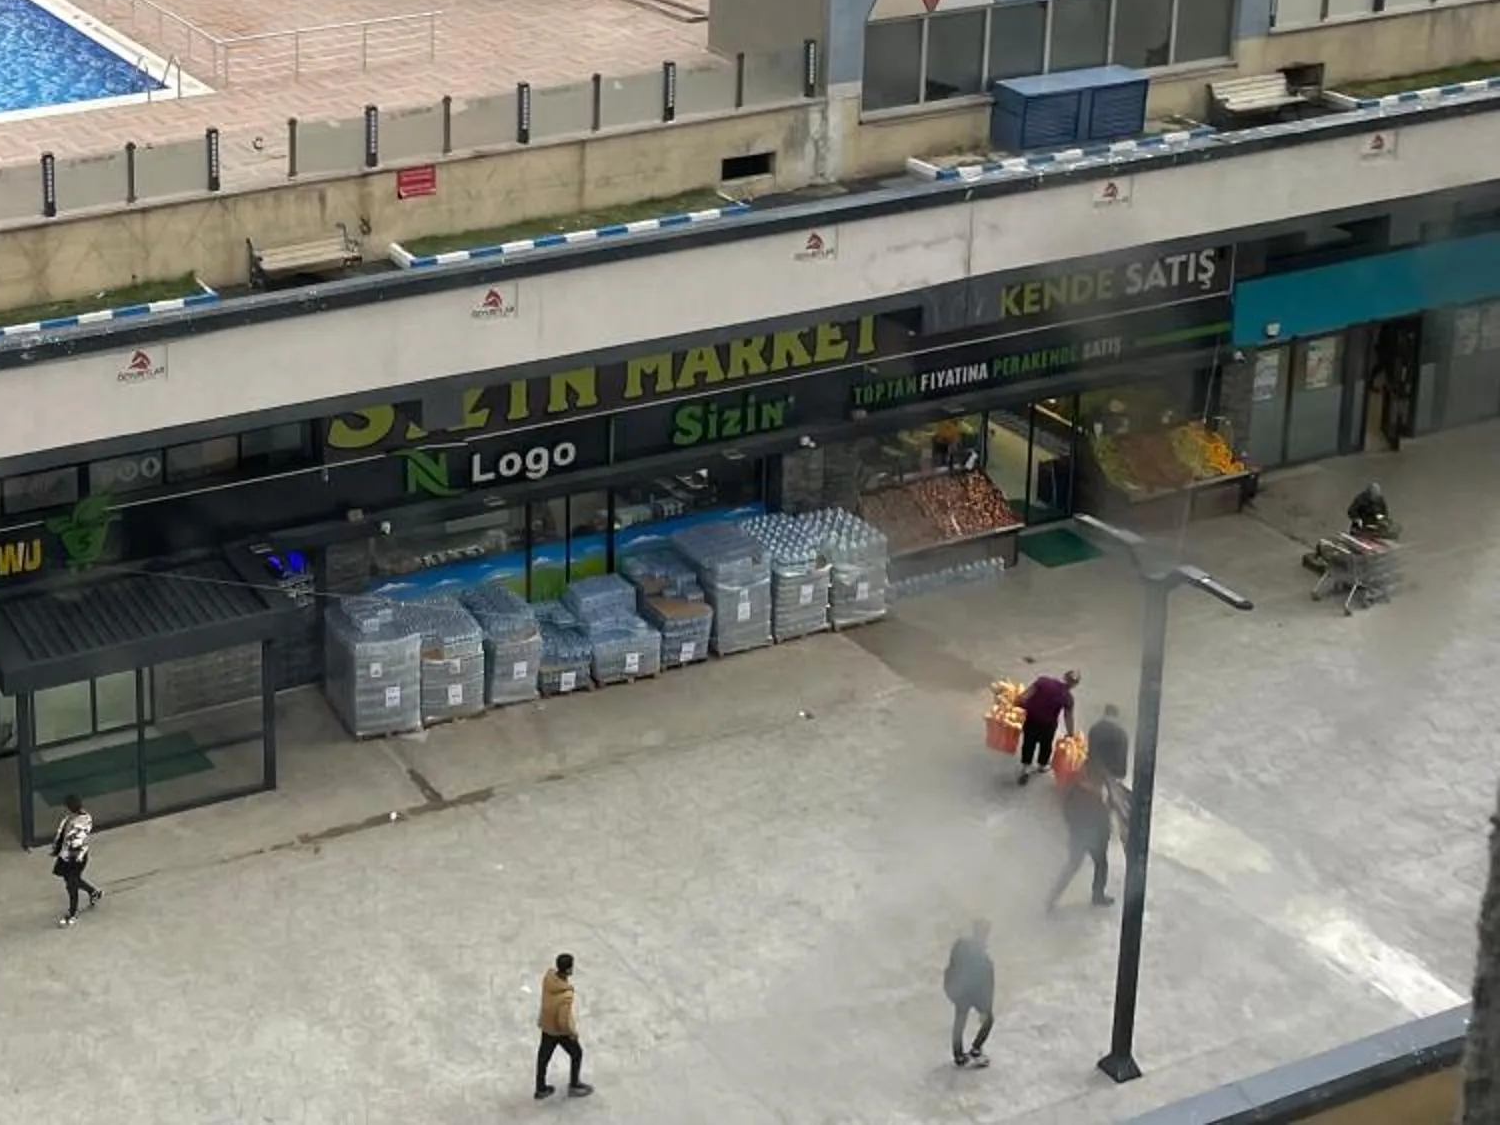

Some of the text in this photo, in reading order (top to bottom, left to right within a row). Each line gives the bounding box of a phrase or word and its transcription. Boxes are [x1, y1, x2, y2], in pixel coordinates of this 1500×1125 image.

[1000, 248, 1216, 318] KENDE SATIŞ
[854, 376, 918, 405] TOPTAN
[993, 346, 1079, 378] PERAKENDE
[471, 442, 577, 483] Logo
